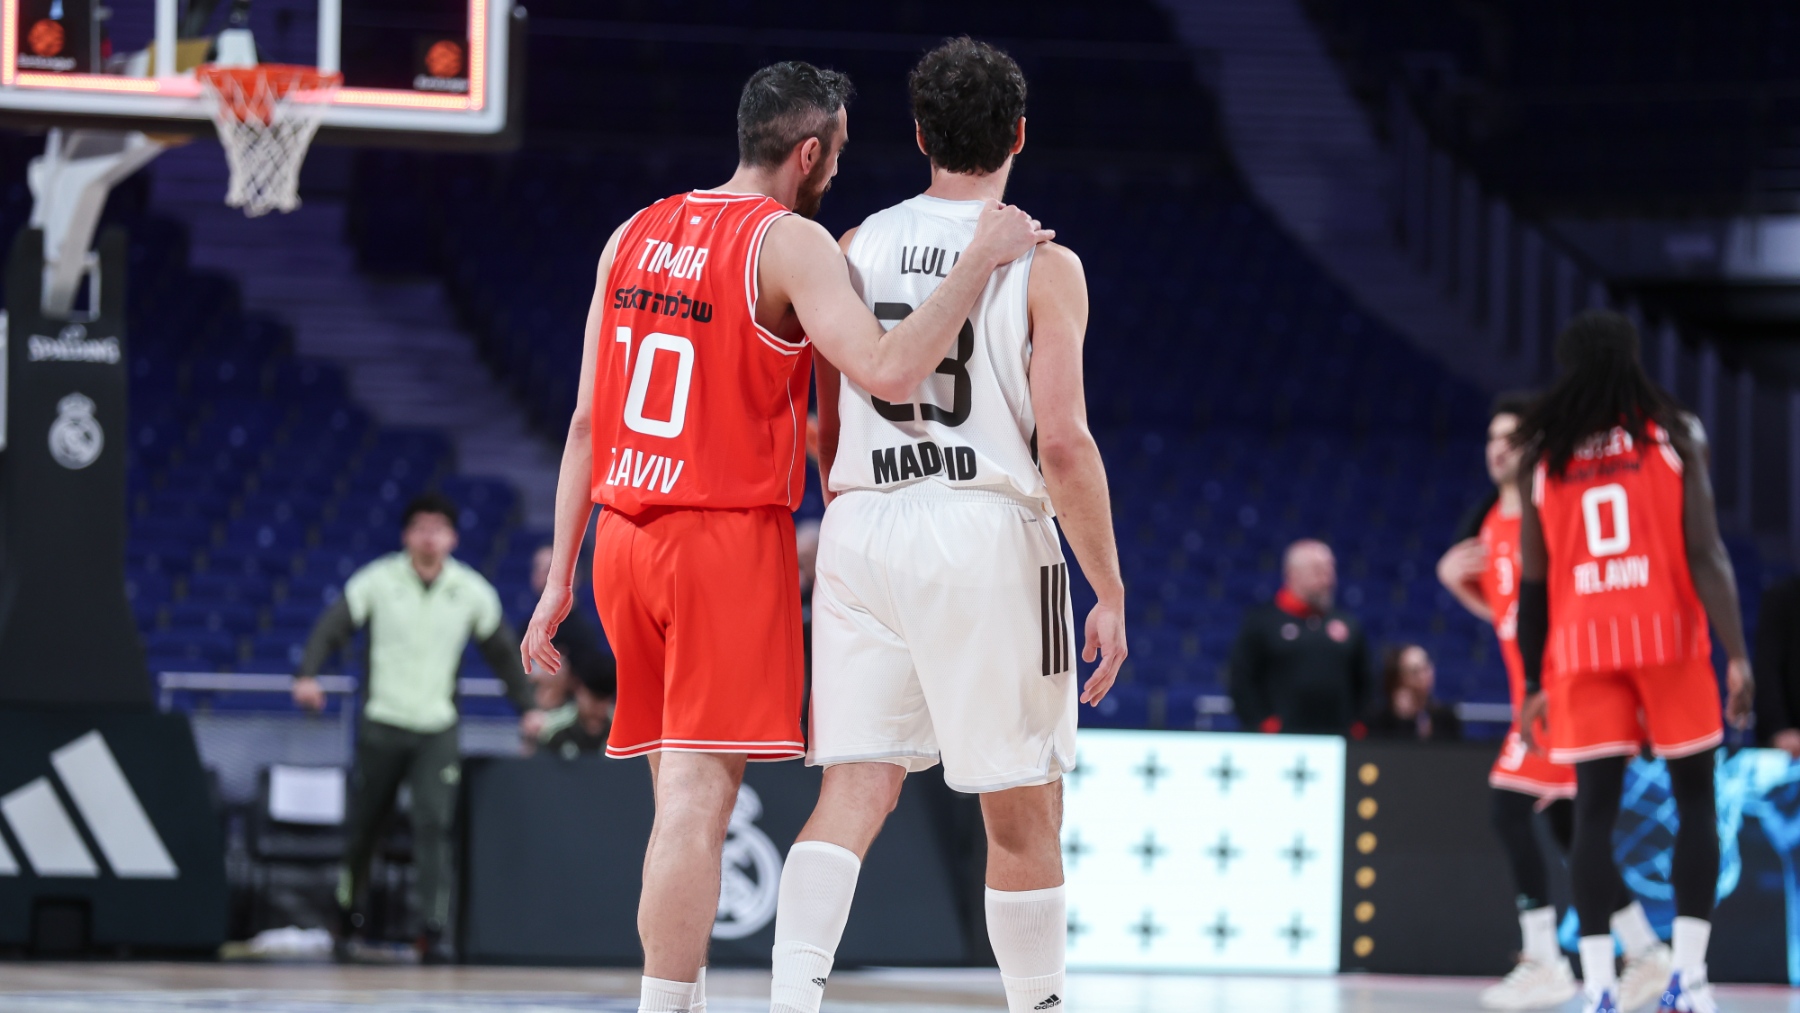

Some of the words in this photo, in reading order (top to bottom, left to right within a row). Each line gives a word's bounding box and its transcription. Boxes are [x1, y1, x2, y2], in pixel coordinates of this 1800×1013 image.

[637, 238, 708, 281] TIMOR
[872, 441, 977, 484] MADID
[1582, 483, 1630, 557] 0
